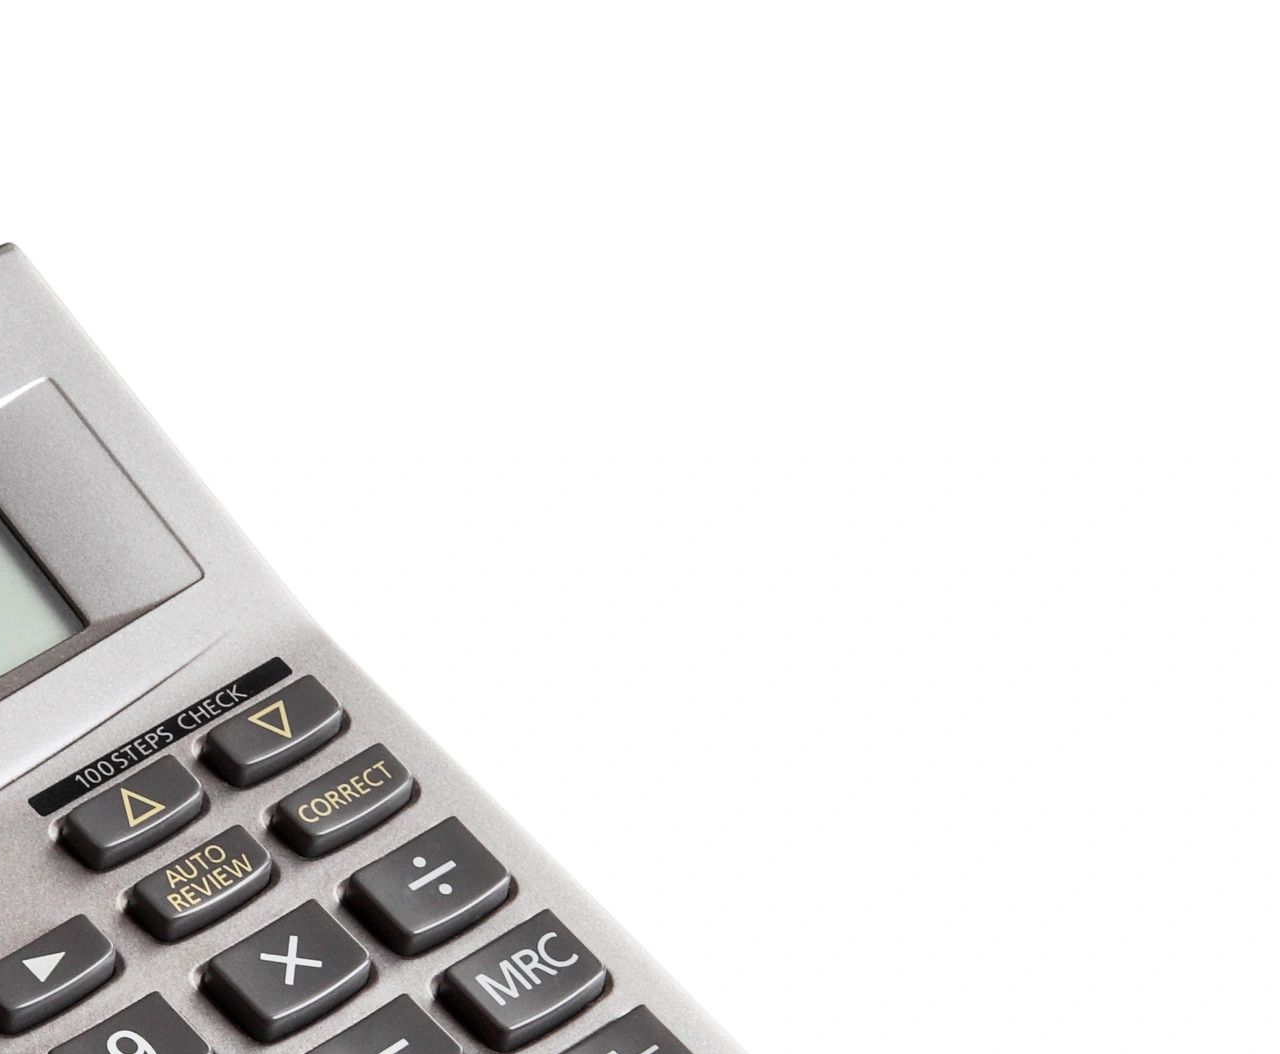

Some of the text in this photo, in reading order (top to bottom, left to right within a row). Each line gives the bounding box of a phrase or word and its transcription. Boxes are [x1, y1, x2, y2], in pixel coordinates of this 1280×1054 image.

[177, 684, 248, 731] CHECK
[297, 760, 394, 824] CORRECT
[165, 844, 227, 889] AUTO
[166, 853, 254, 911] REVIEW
[475, 931, 579, 1006] MRC
